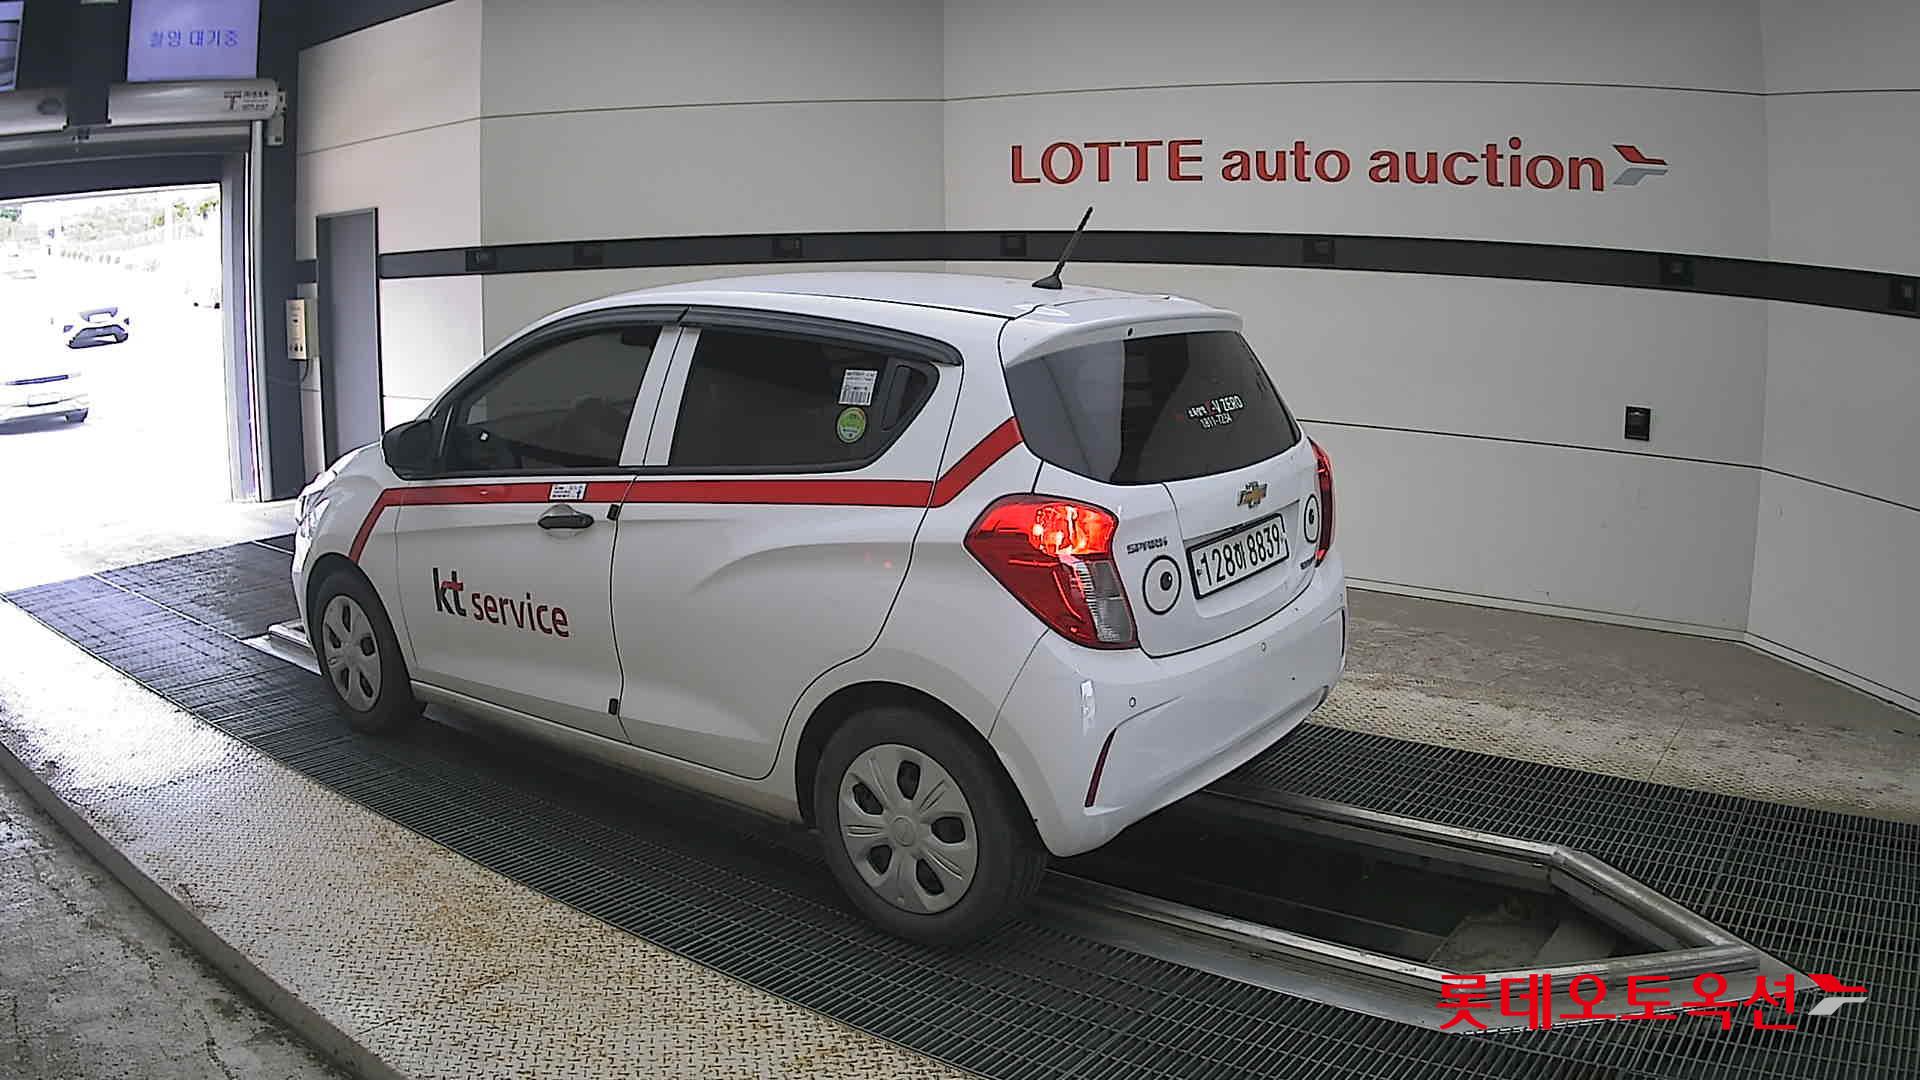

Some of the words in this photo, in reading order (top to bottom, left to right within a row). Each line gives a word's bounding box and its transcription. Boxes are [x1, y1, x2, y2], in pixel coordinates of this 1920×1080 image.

[190, 29, 239, 48] 대기중
[1010, 139, 1203, 185] LOTTE
[1221, 140, 1351, 183] auto
[1368, 136, 1605, 192] auction
[1246, 523, 1281, 566] 8839
[432, 567, 467, 617] kt
[471, 592, 570, 638] service
